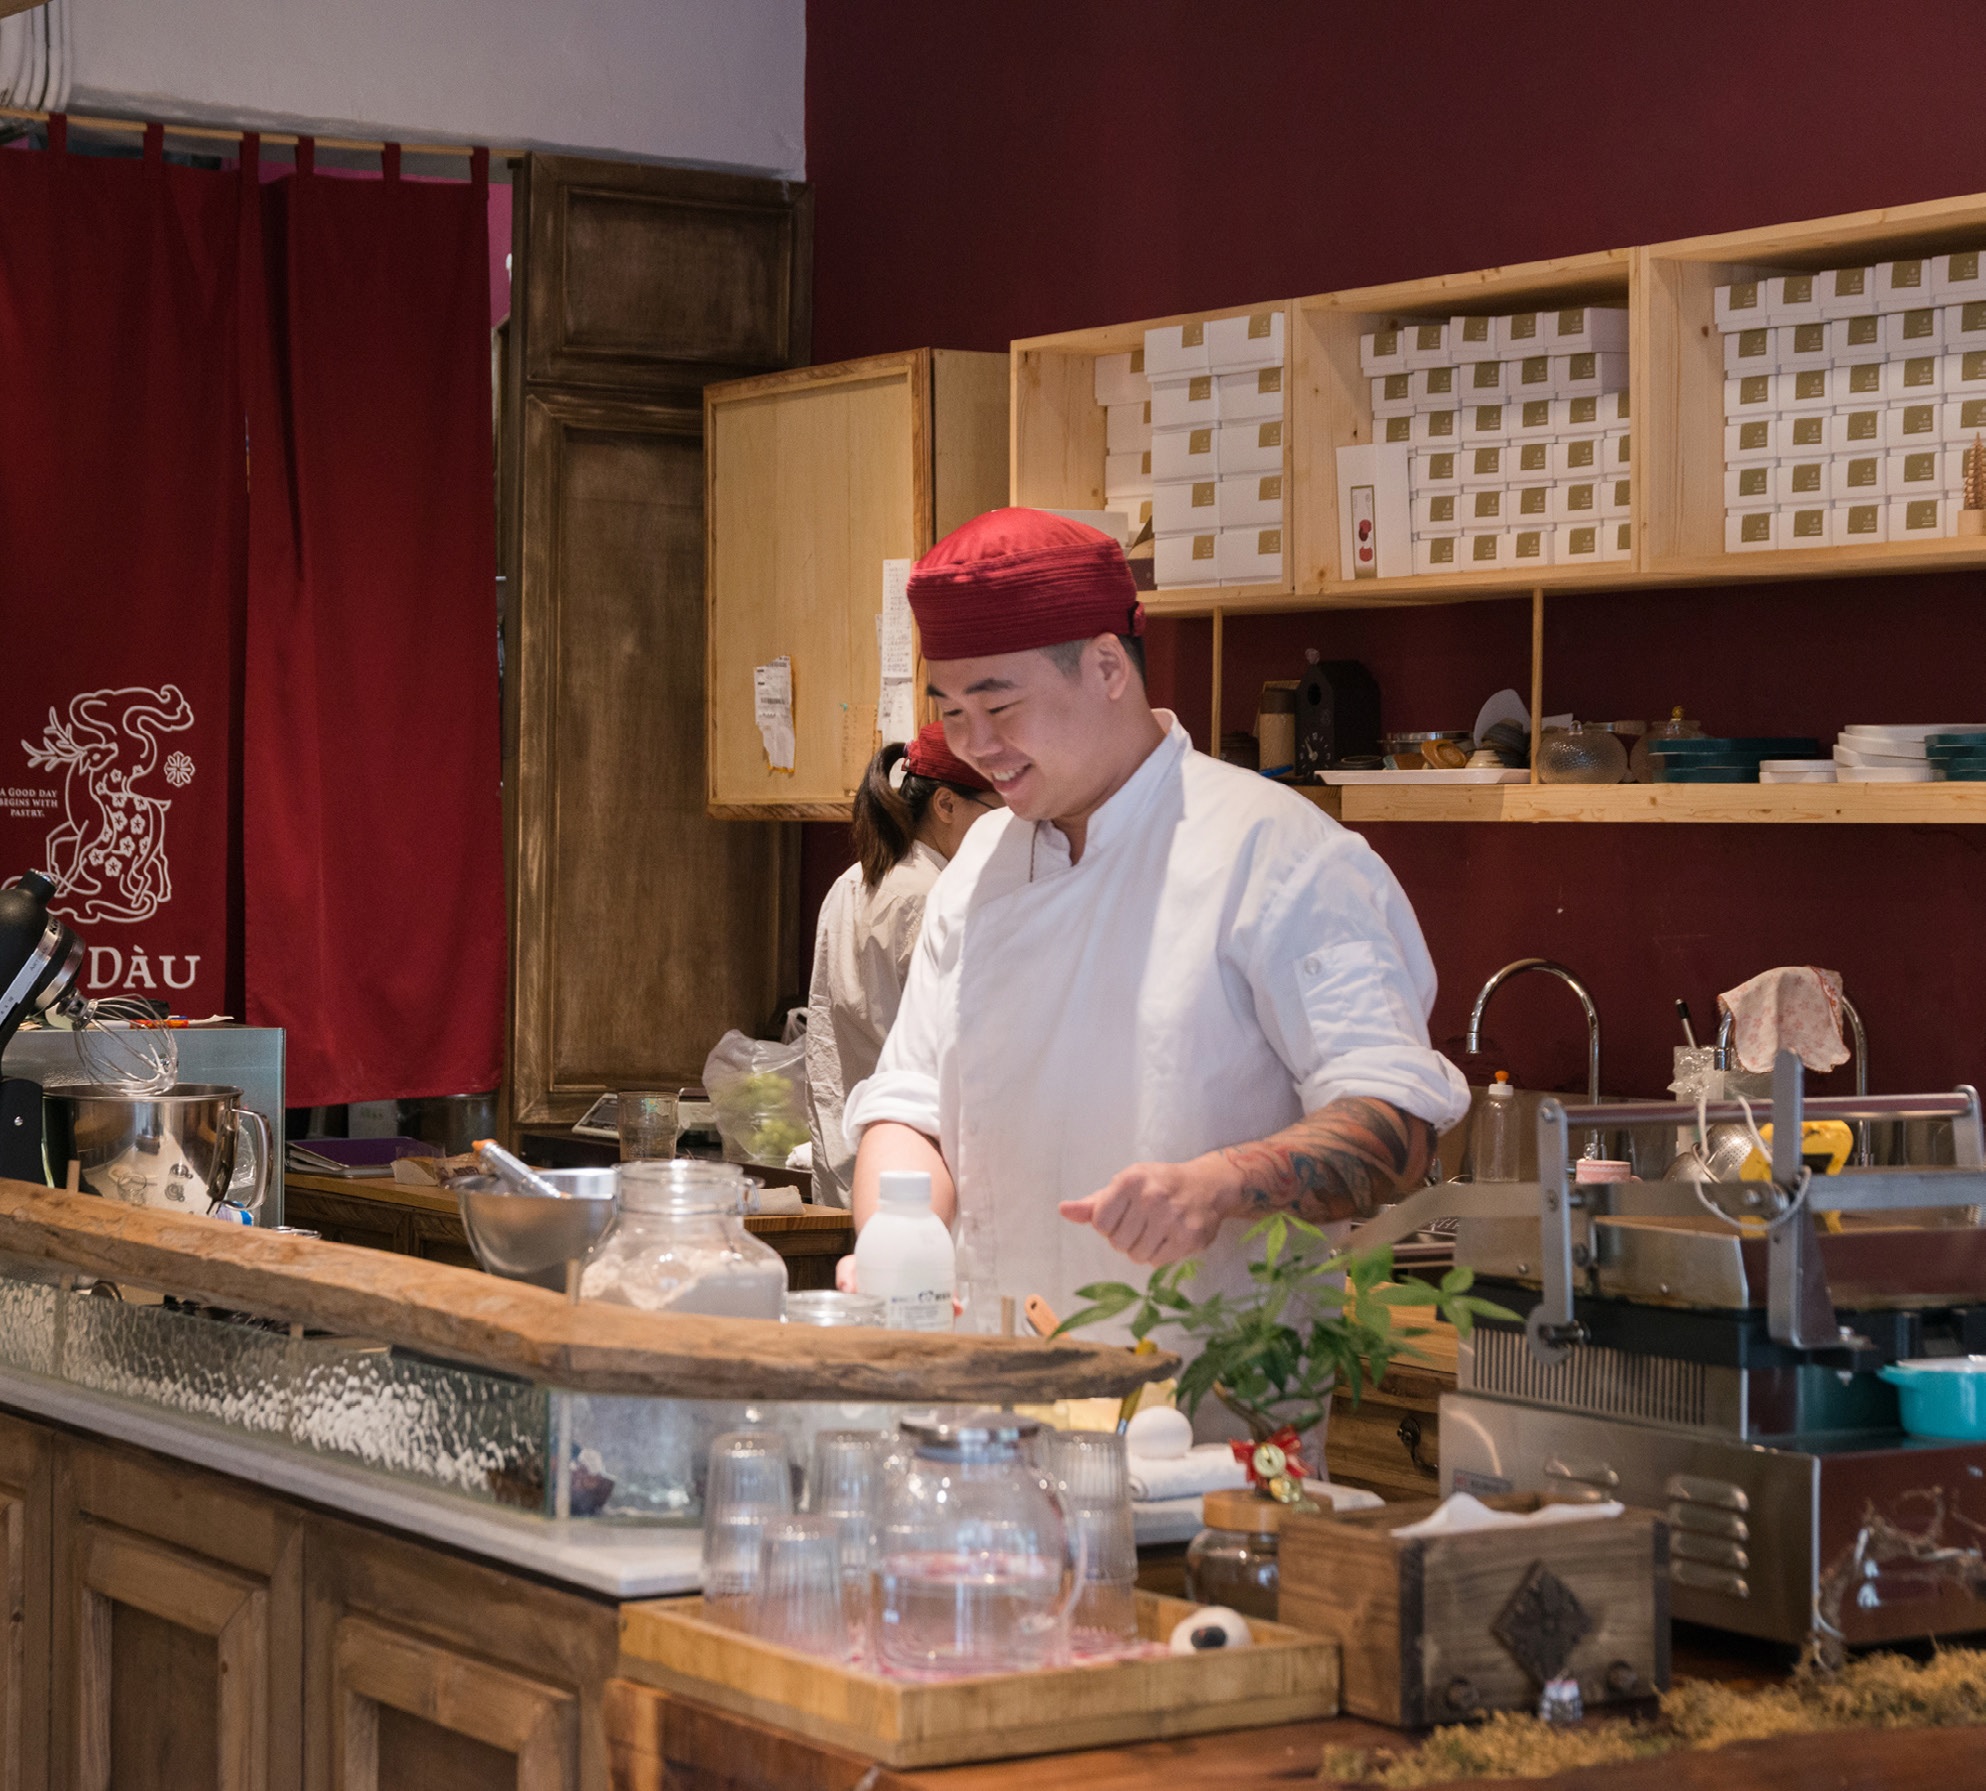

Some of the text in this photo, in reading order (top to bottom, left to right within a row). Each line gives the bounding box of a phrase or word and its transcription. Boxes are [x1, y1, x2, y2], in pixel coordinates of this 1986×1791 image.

[0, 787, 58, 798] A GOOD DAY
[32, 798, 59, 808] WITH
[10, 809, 46, 818] PASTRY.
[86, 944, 201, 989] DÀU
